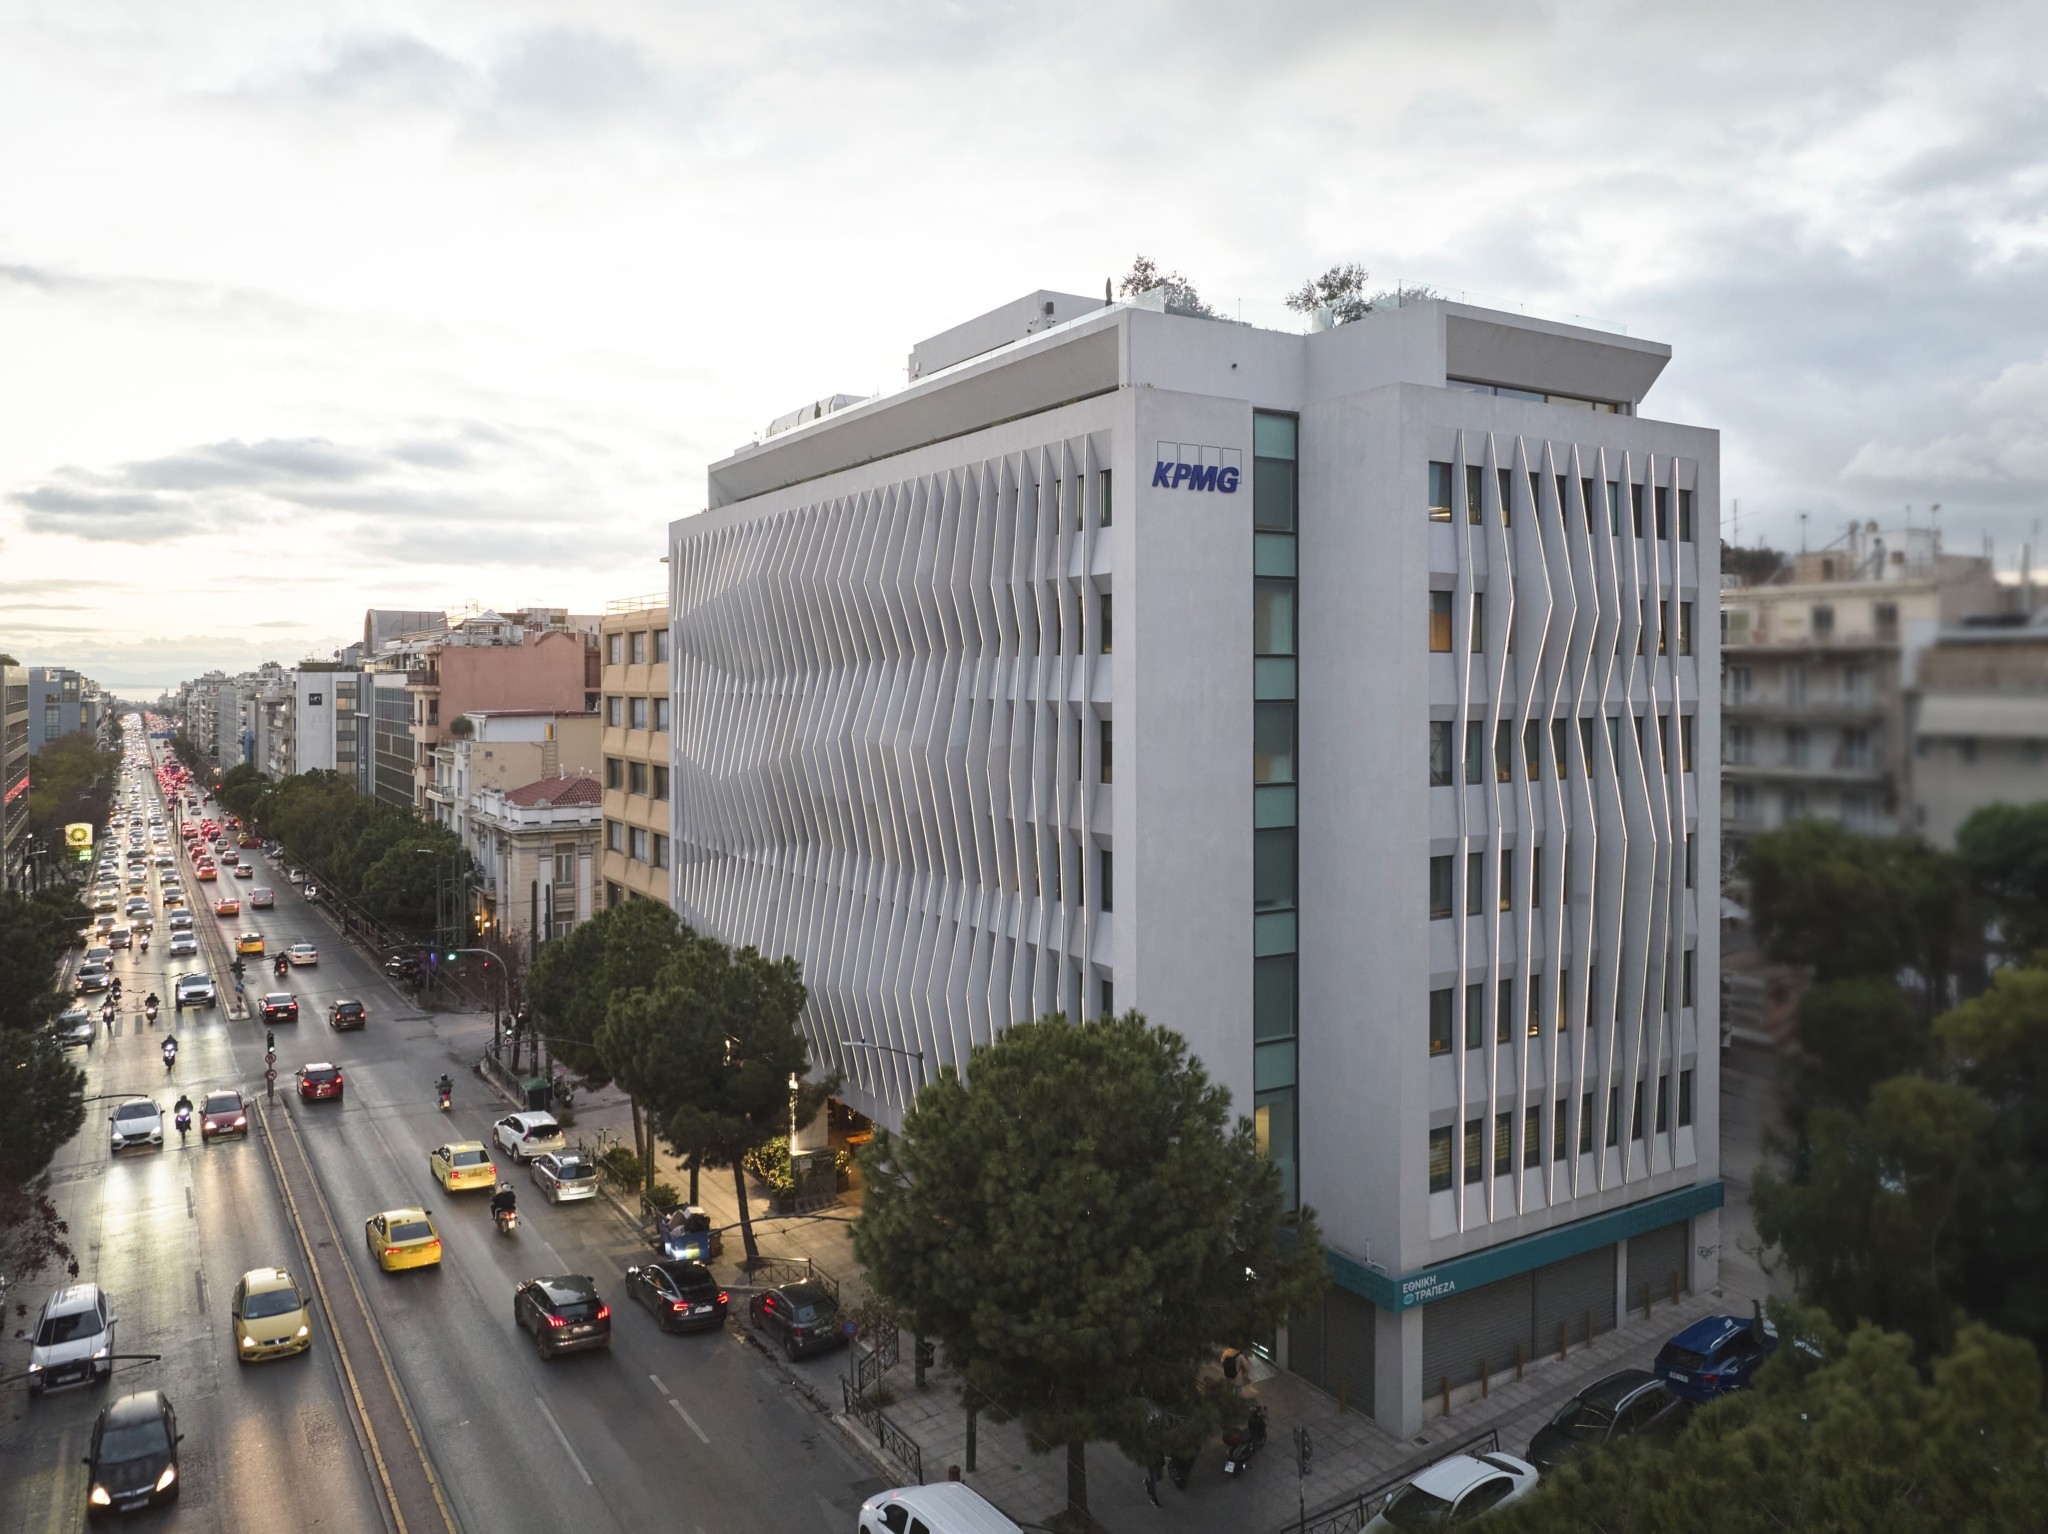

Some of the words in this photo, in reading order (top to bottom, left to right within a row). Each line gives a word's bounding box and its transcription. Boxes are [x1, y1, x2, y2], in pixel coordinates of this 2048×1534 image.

[1152, 461, 1239, 493] KPMG
[1402, 1275, 1436, 1293] ΕΘΝΙΚΗ
[1415, 1281, 1455, 1301] ΤΡΑΠΕΖΑ
